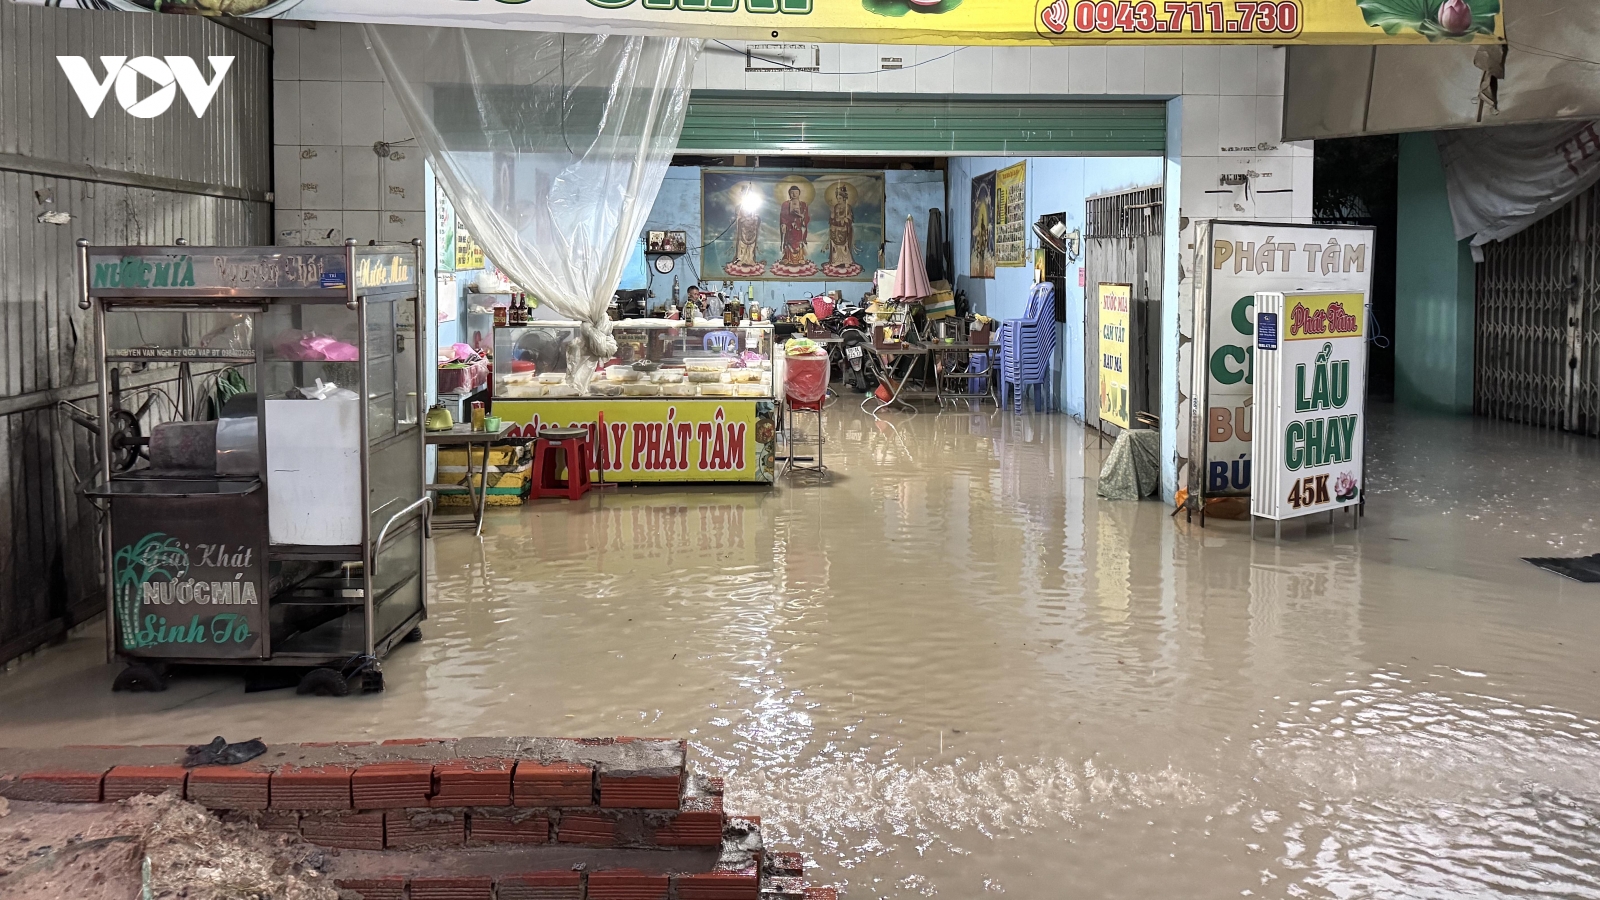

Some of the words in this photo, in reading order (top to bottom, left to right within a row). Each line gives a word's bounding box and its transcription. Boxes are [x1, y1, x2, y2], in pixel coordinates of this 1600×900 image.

[1074, 1, 1299, 33] 0943.711.730
[1214, 236, 1296, 275] PHÁT
[1303, 238, 1365, 276] TÂM
[1290, 302, 1326, 335] Phát
[1327, 301, 1358, 333] Tâm
[142, 349, 155, 357] VAN
[1295, 342, 1349, 413] LẨU
[631, 406, 692, 471] PHÁT
[697, 406, 747, 471] TÂM
[1284, 414, 1358, 471] CHAY
[1287, 474, 1330, 509] 45K
[193, 543, 252, 568] Khát
[135, 614, 207, 648] Sinh
